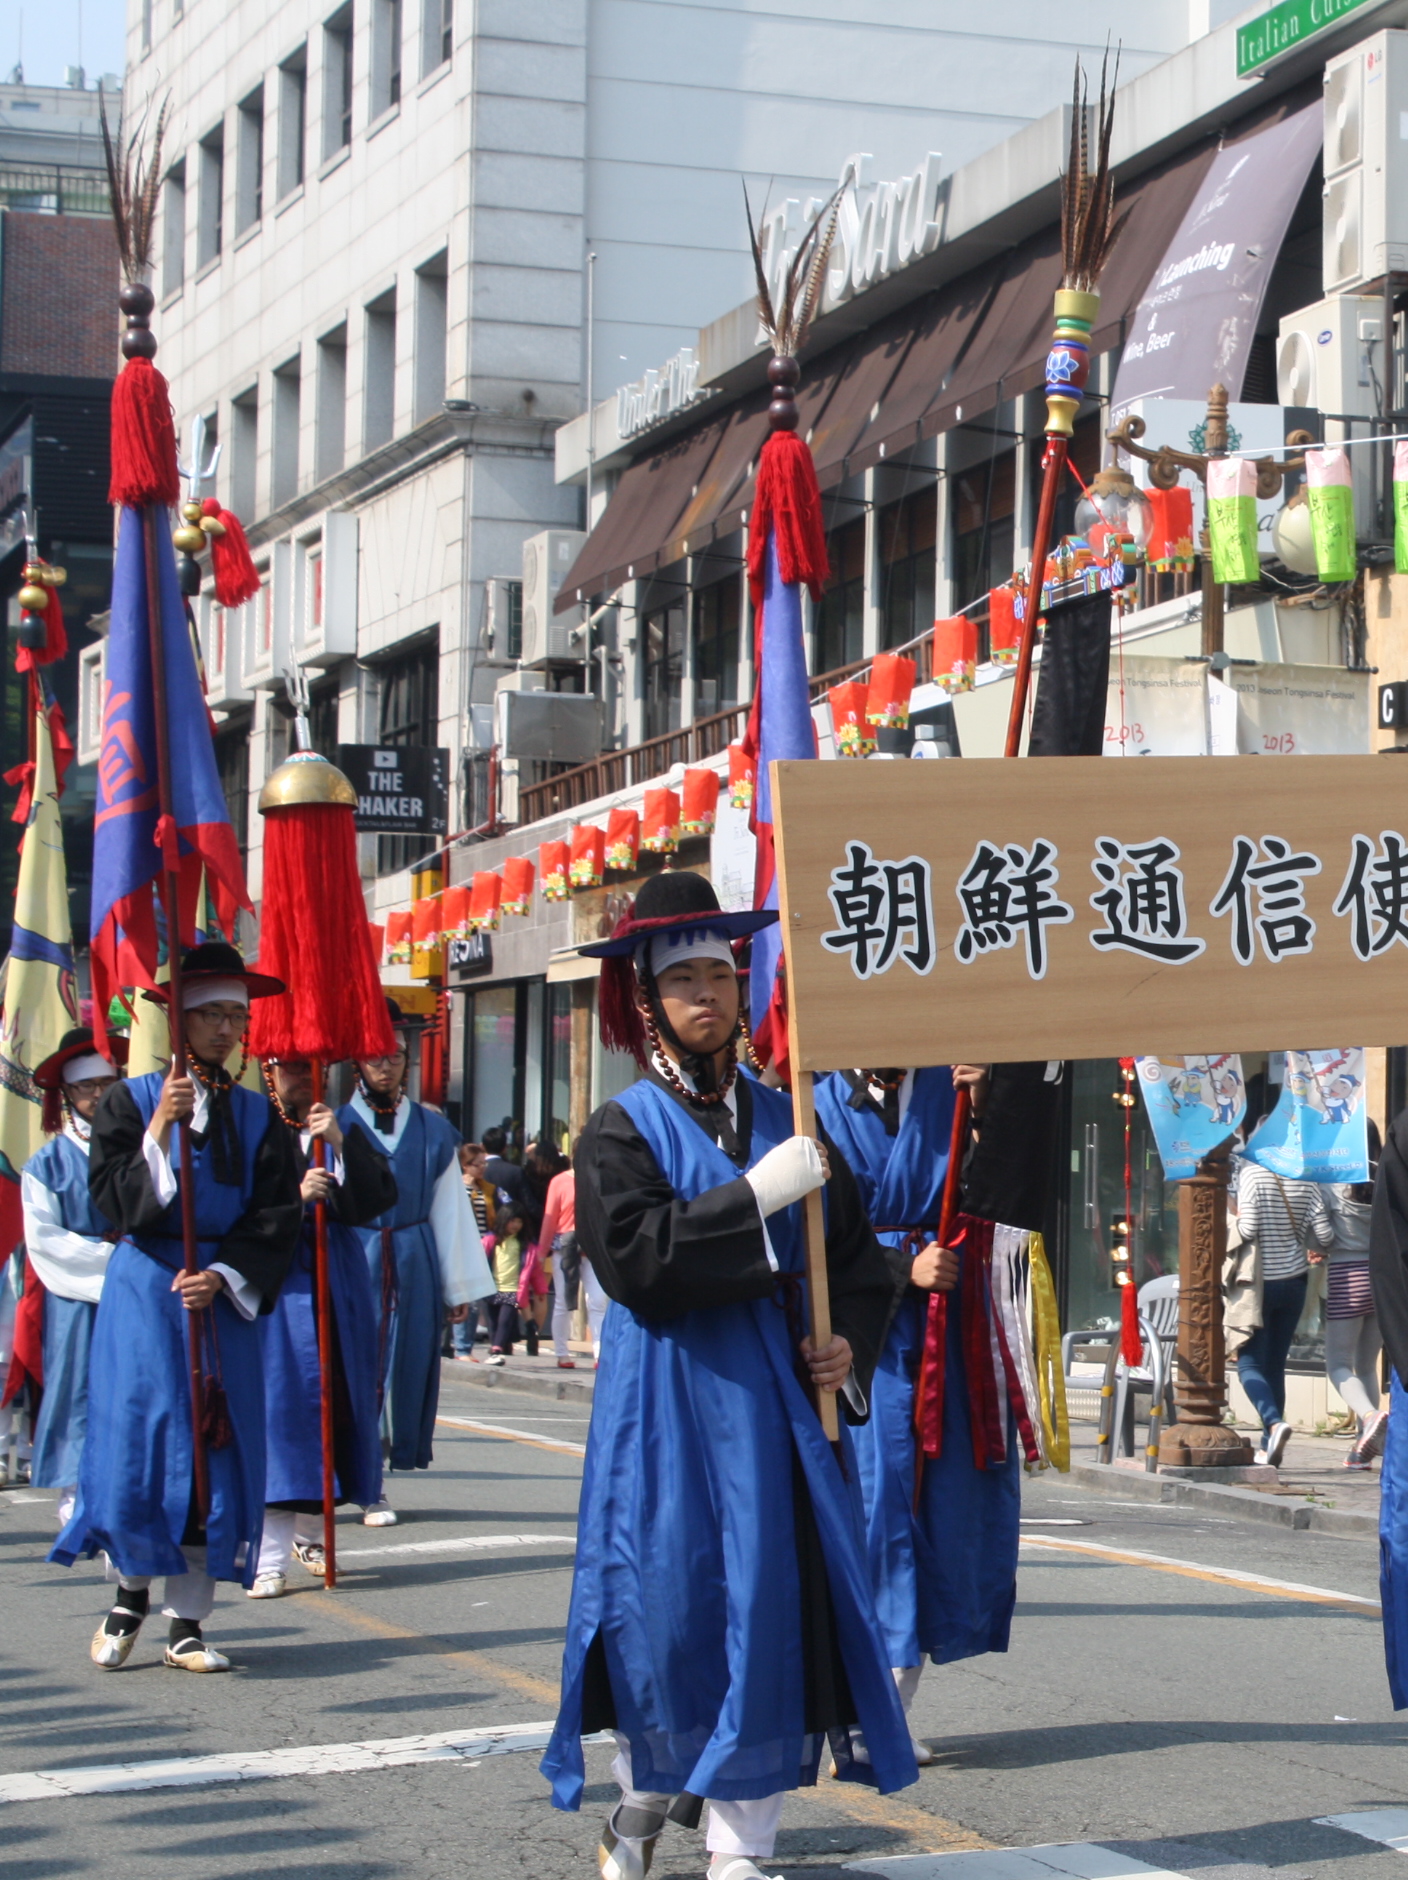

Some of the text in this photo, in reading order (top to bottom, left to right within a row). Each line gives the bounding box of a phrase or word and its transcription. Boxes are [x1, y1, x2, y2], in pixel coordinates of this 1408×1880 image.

[1240, 14, 1299, 67] Italian
[1146, 331, 1176, 354] Beer
[1170, 679, 1202, 688] Festival
[1236, 683, 1256, 694] 2013
[1284, 686, 1324, 700] Tongsinsa
[1325, 689, 1356, 701] Festival
[1104, 722, 1145, 744] 2013
[1262, 732, 1295, 754] 2013
[367, 771, 403, 792] THE
[353, 796, 423, 818] HAKER
[431, 818, 446, 829] 2F
